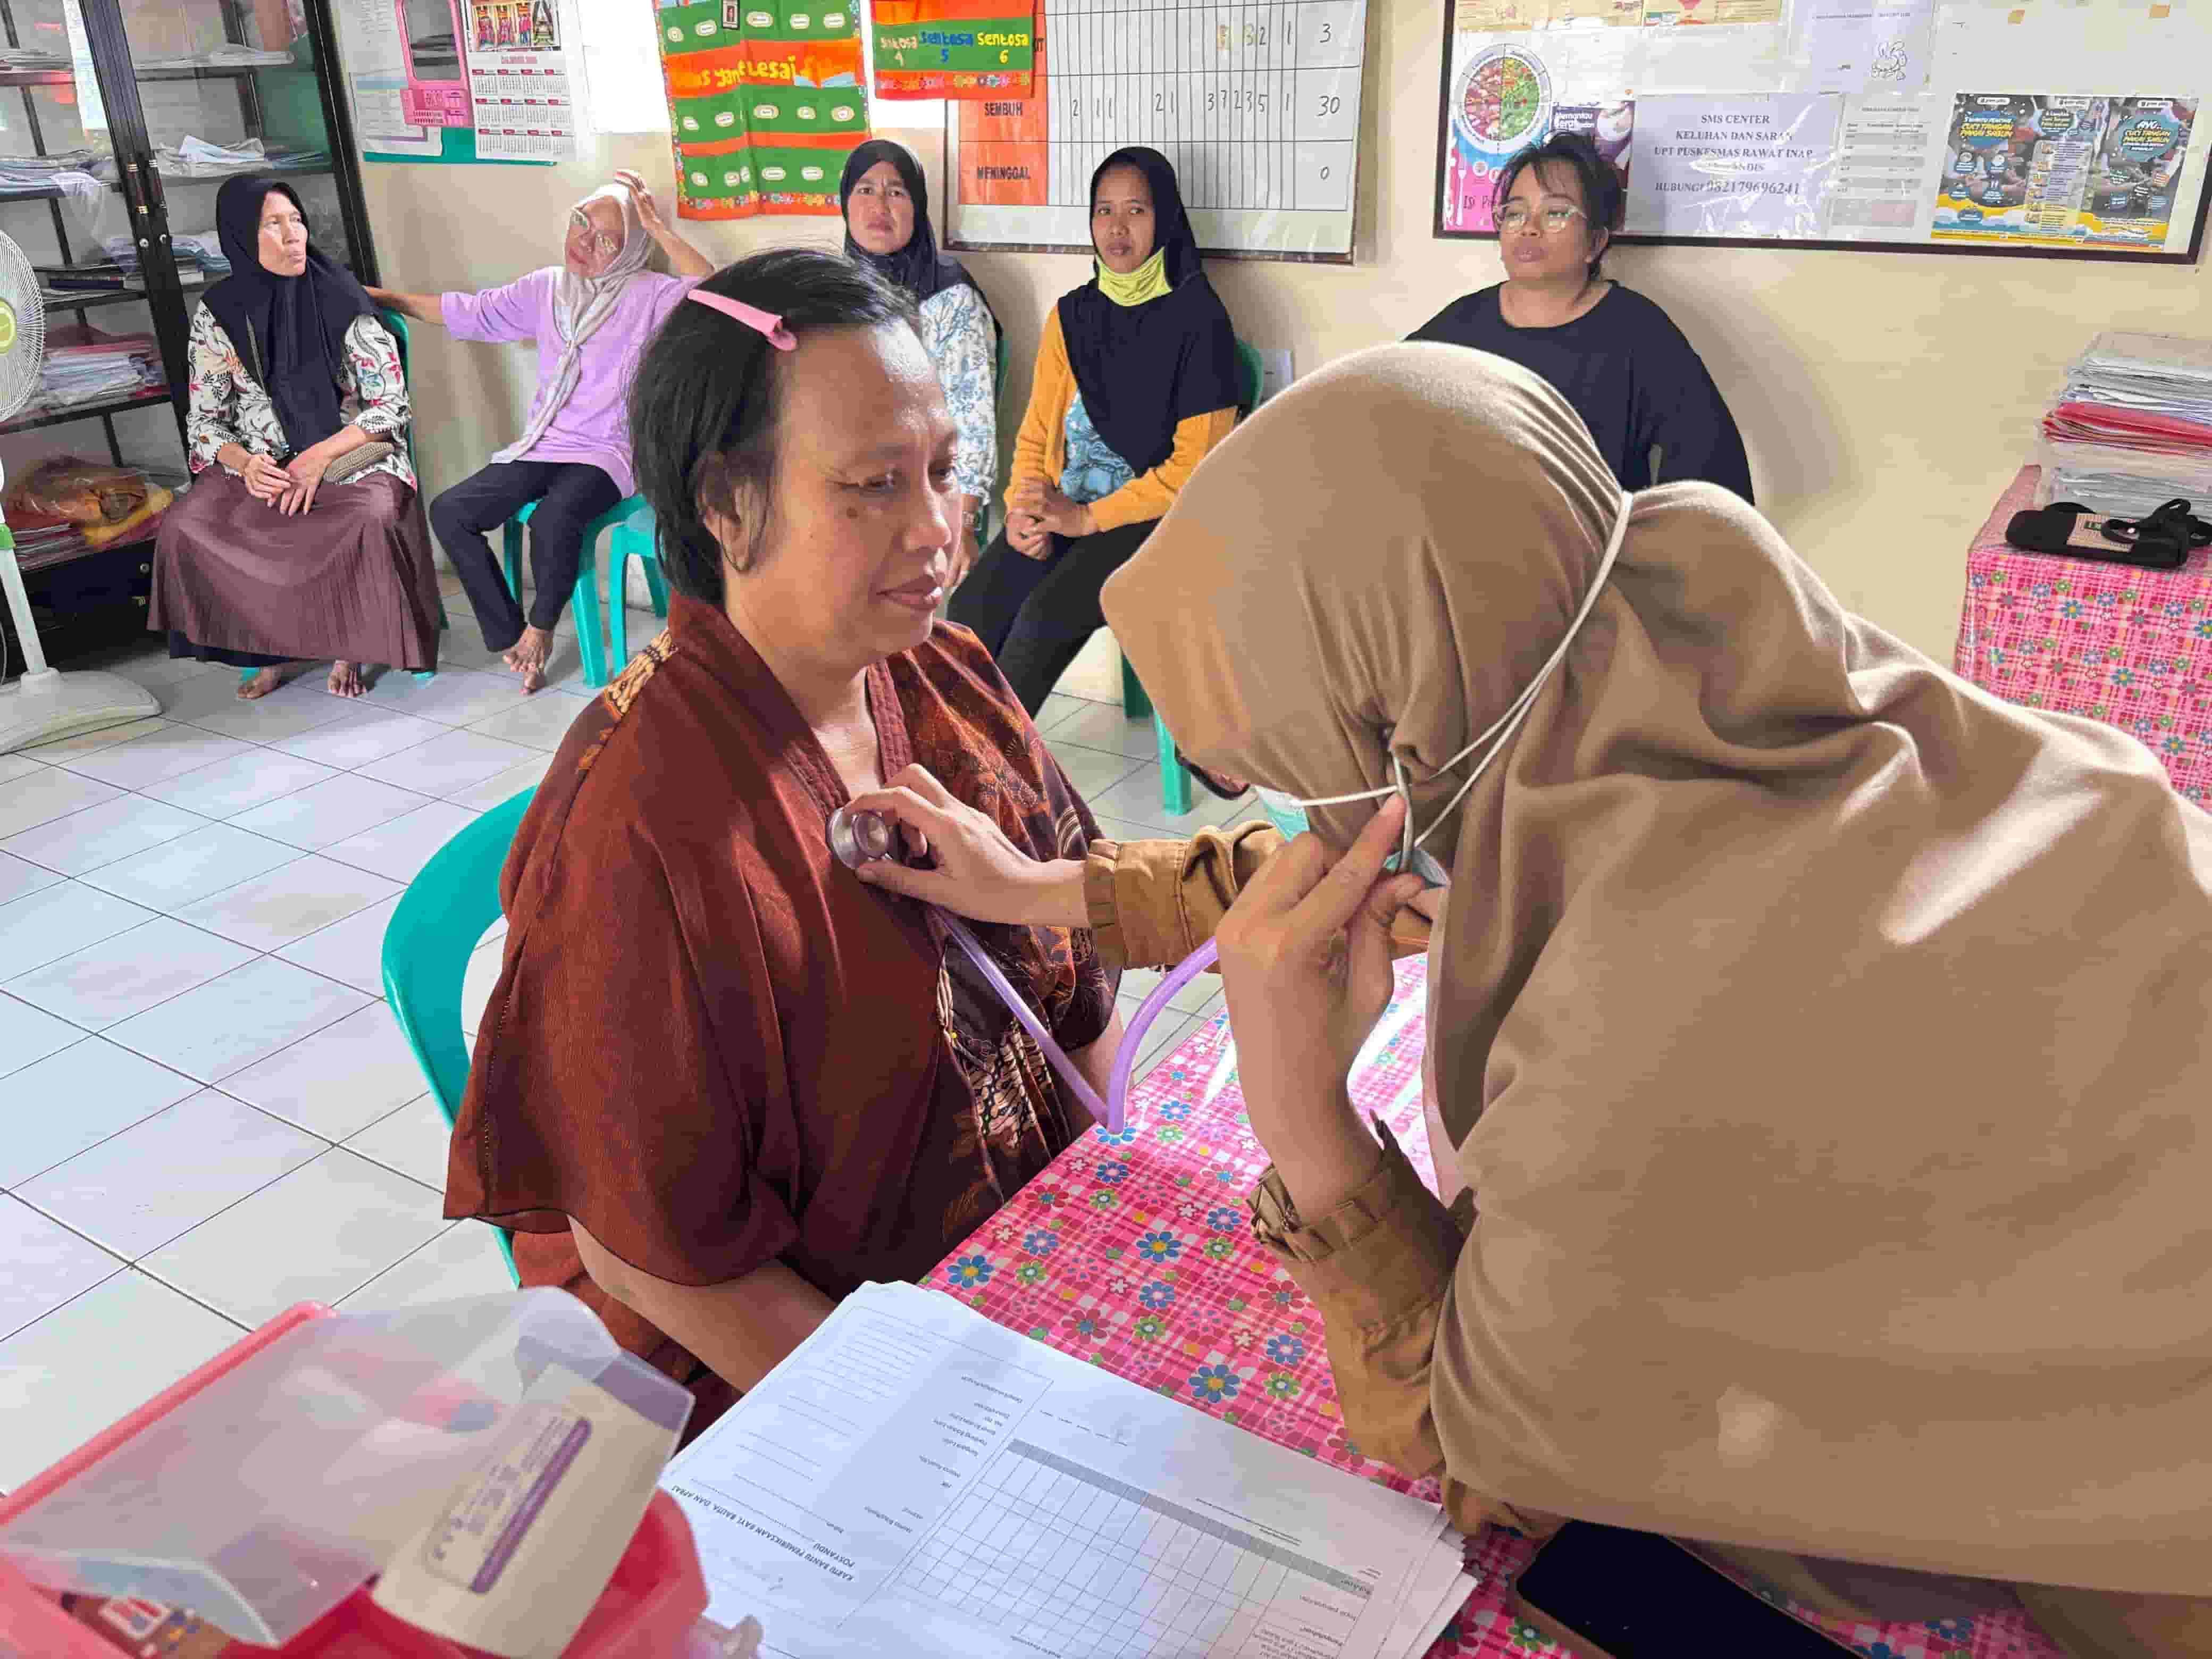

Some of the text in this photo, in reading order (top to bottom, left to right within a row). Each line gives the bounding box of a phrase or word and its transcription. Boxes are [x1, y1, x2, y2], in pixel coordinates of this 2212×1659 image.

[977, 32, 1030, 47] Sentosa
[1259, 26, 1267, 46] 2
[1319, 23, 1331, 43] 3
[940, 48, 949, 63] 5
[999, 50, 1009, 64] 6
[984, 102, 1023, 116] SEMBUH
[1316, 95, 1340, 116] 30
[1701, 114, 1770, 124] SMS CENTER
[1675, 130, 1728, 141] KELUHAN
[1731, 131, 1753, 140] DAN
[1654, 147, 1813, 158] UPT PUSKESMAS RAWAT INAP
[977, 166, 1030, 180] MENINGGAL
